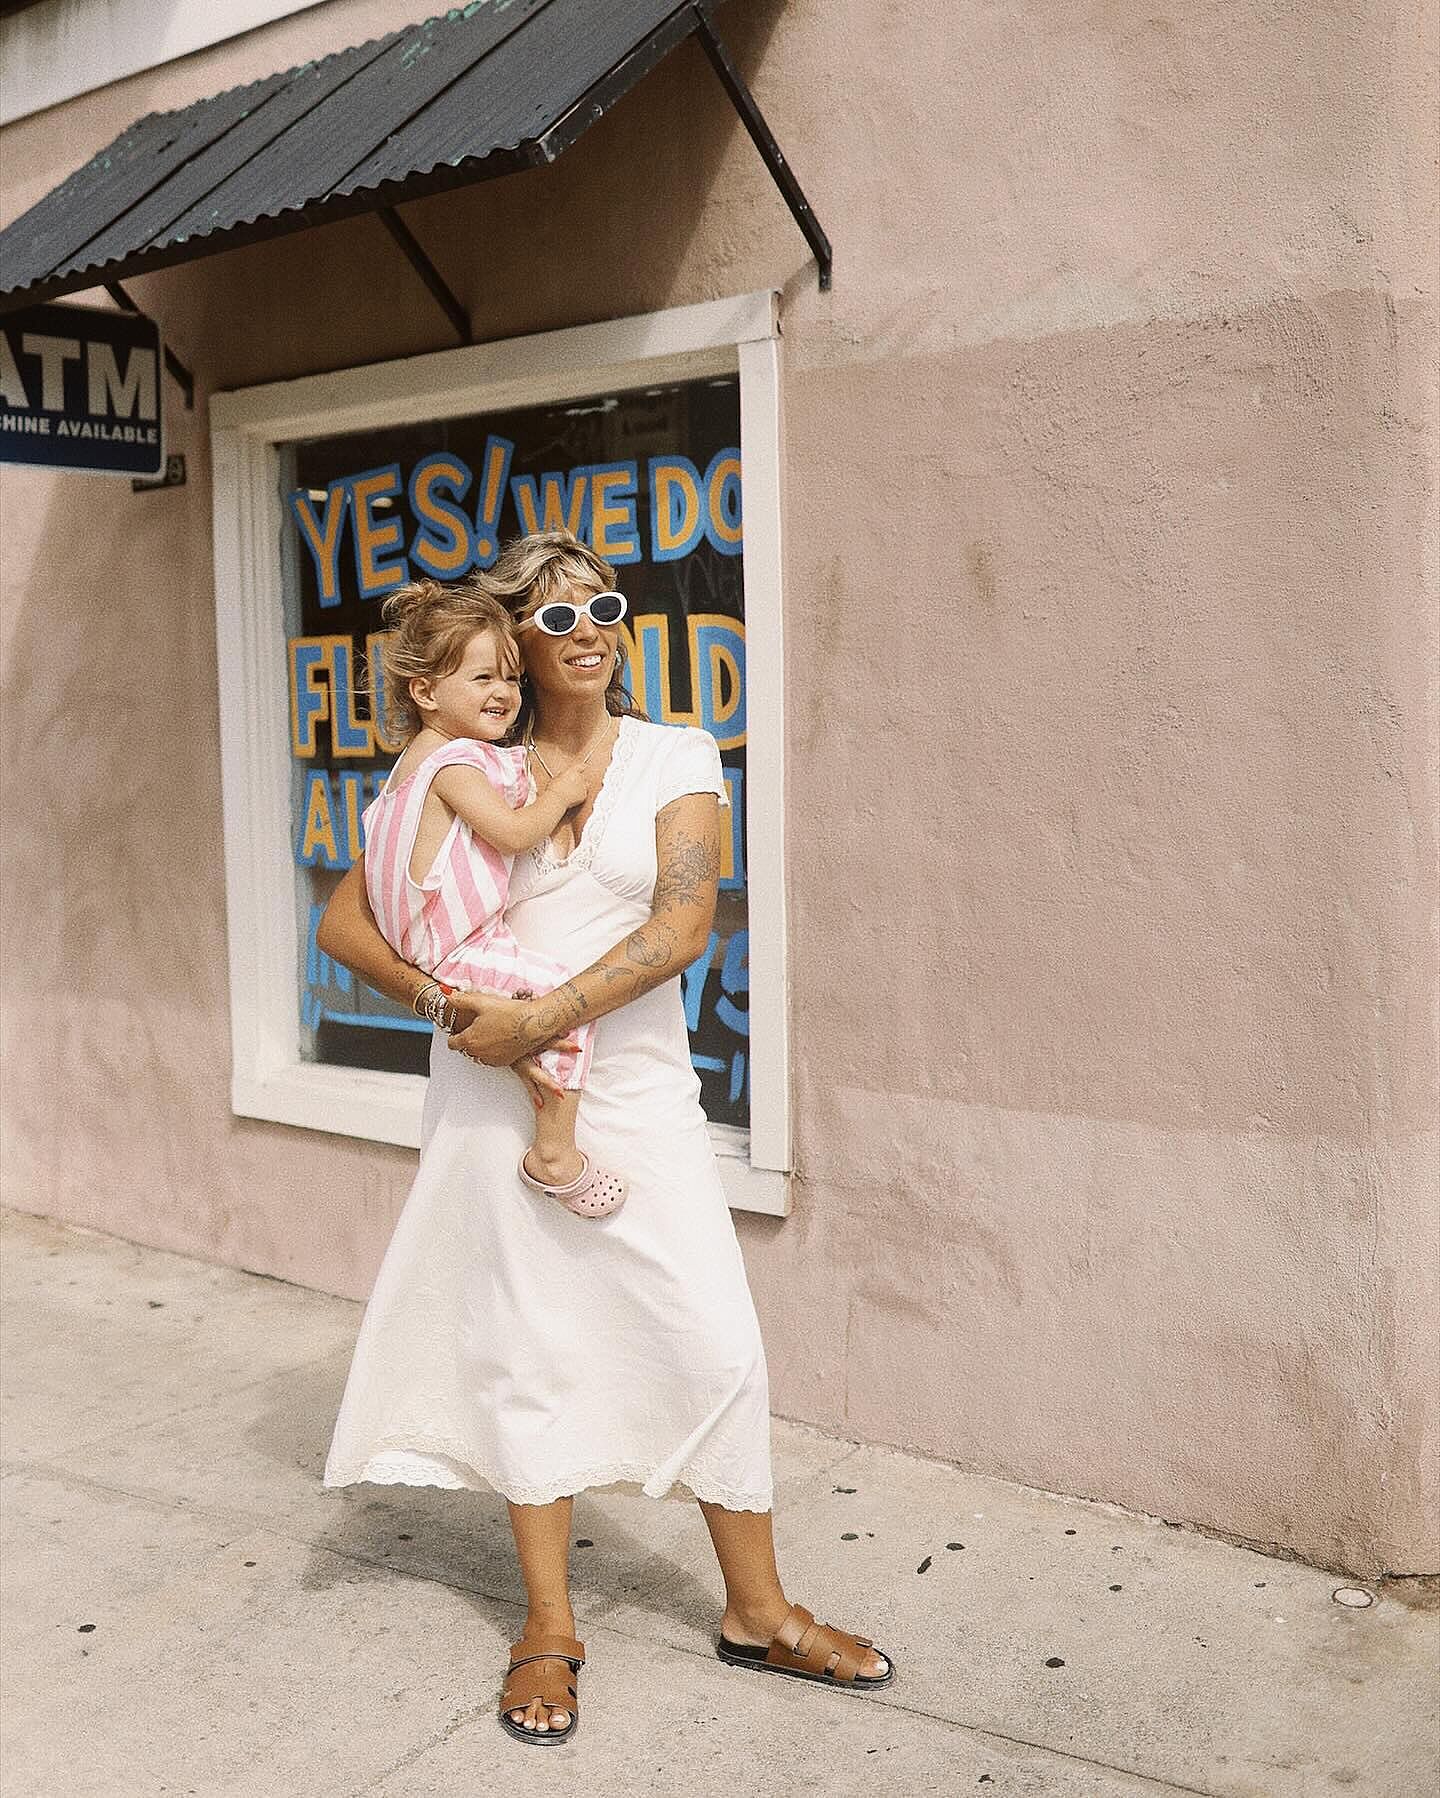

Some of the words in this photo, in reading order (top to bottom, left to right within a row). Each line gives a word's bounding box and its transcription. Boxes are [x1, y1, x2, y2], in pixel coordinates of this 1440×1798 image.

[0, 414, 50, 435] HINE
[56, 419, 158, 444] AVAILABLE
[291, 435, 514, 607] YES!
[511, 459, 642, 565] WE
[648, 446, 743, 564] DO
